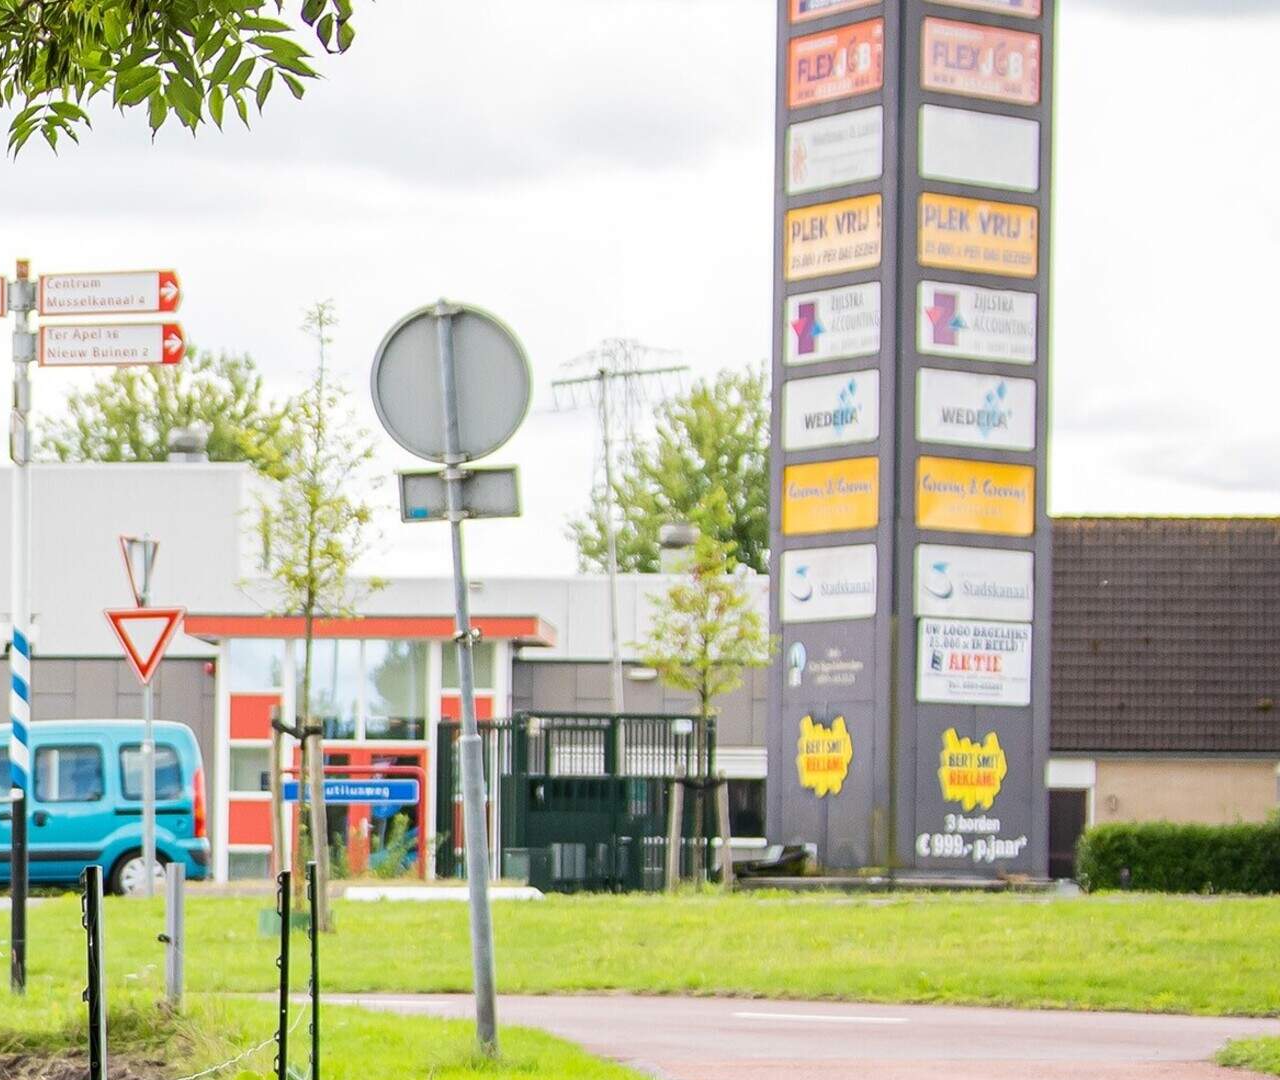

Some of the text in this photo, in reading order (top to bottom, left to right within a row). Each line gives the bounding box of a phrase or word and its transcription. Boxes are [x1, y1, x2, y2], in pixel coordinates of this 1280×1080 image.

[792, 214, 828, 243] PLEK
[835, 206, 869, 235] VRIJ
[925, 204, 970, 233] PLEK
[979, 211, 1021, 240] VRIJ
[47, 278, 101, 289] Centrum
[47, 295, 134, 307] Musselkanaal
[47, 328, 67, 340] Ter
[72, 328, 102, 342] Apel
[47, 347, 86, 358] Nieuw
[93, 346, 138, 358] Buinen
[961, 579, 1030, 600] Stadskanaal
[944, 625, 970, 636] LOGO
[948, 653, 1002, 673] AKTIE
[948, 753, 973, 767] BERT
[944, 813, 1000, 833] 3 borden
[916, 832, 930, 857] €
